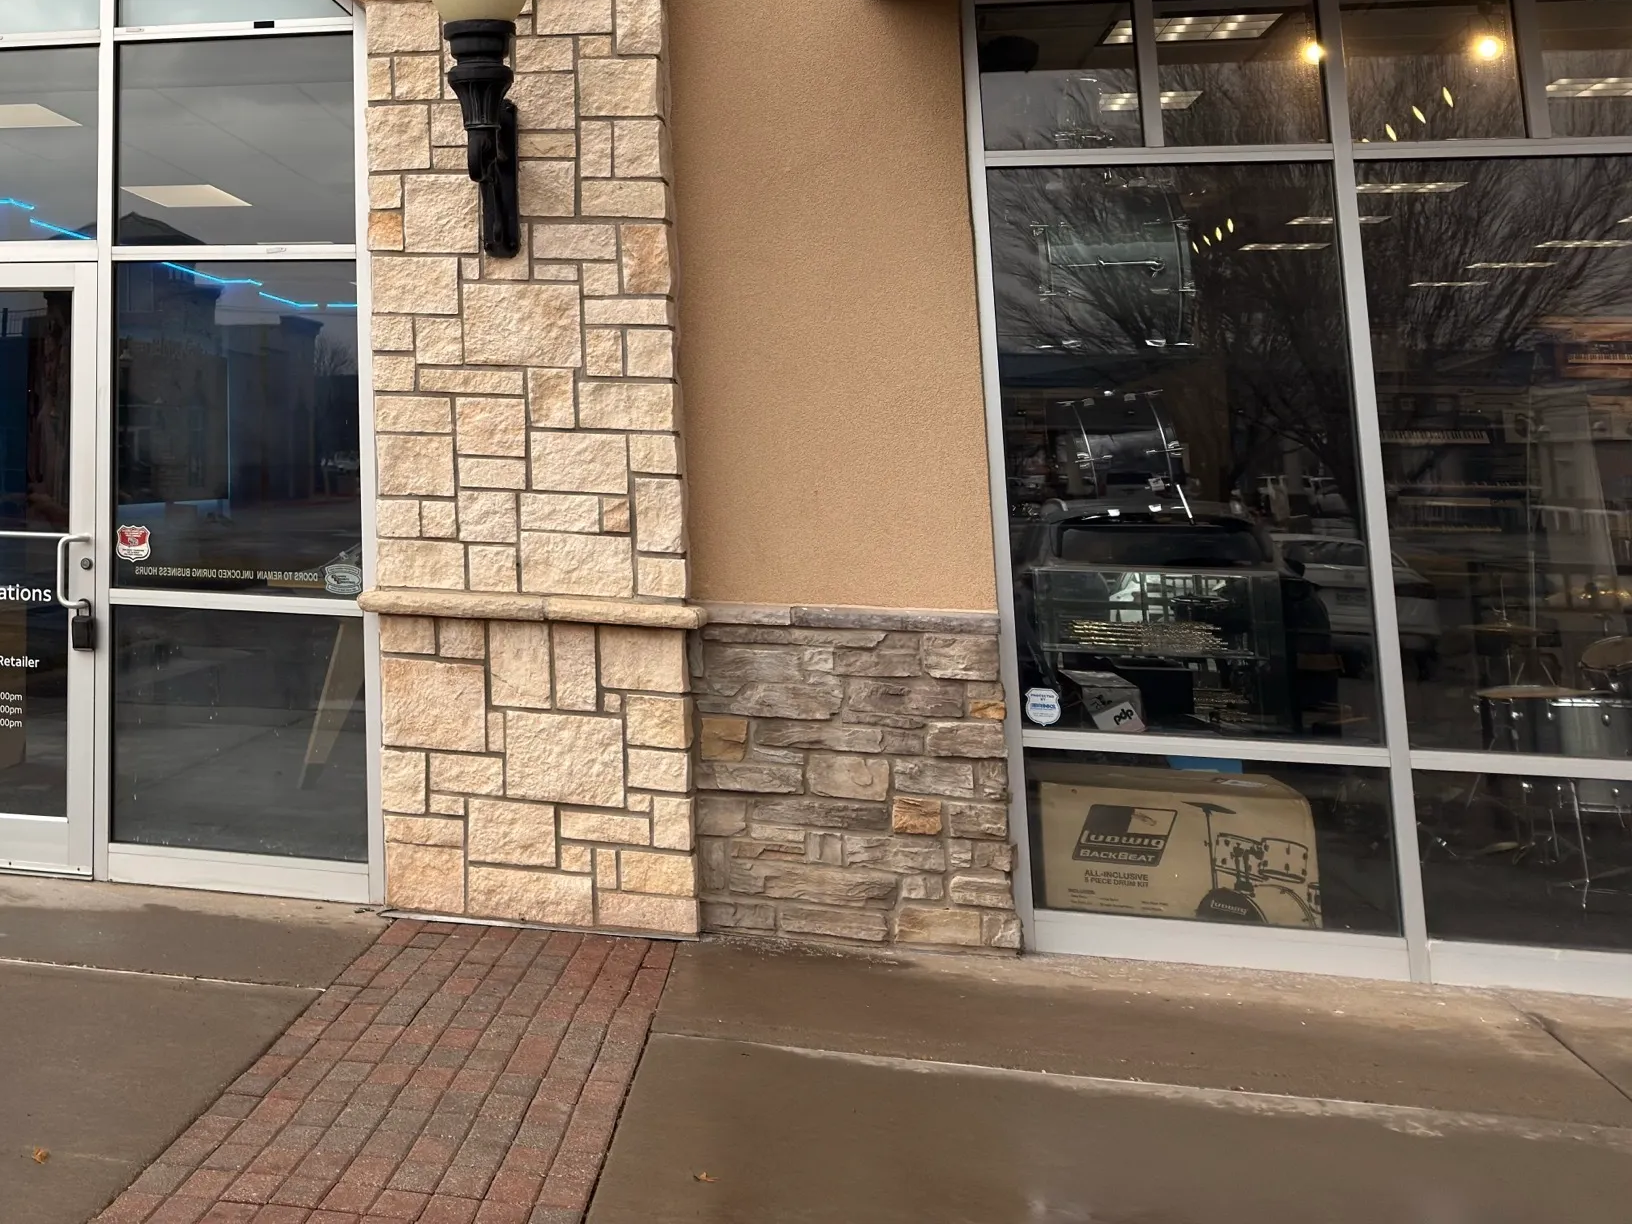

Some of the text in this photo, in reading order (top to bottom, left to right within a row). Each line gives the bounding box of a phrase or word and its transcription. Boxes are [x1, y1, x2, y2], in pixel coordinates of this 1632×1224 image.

[1113, 708, 1134, 726] pdp
[1084, 869, 1149, 882] ALL-INCLUSIVE
[1089, 877, 1112, 885] PIECE
